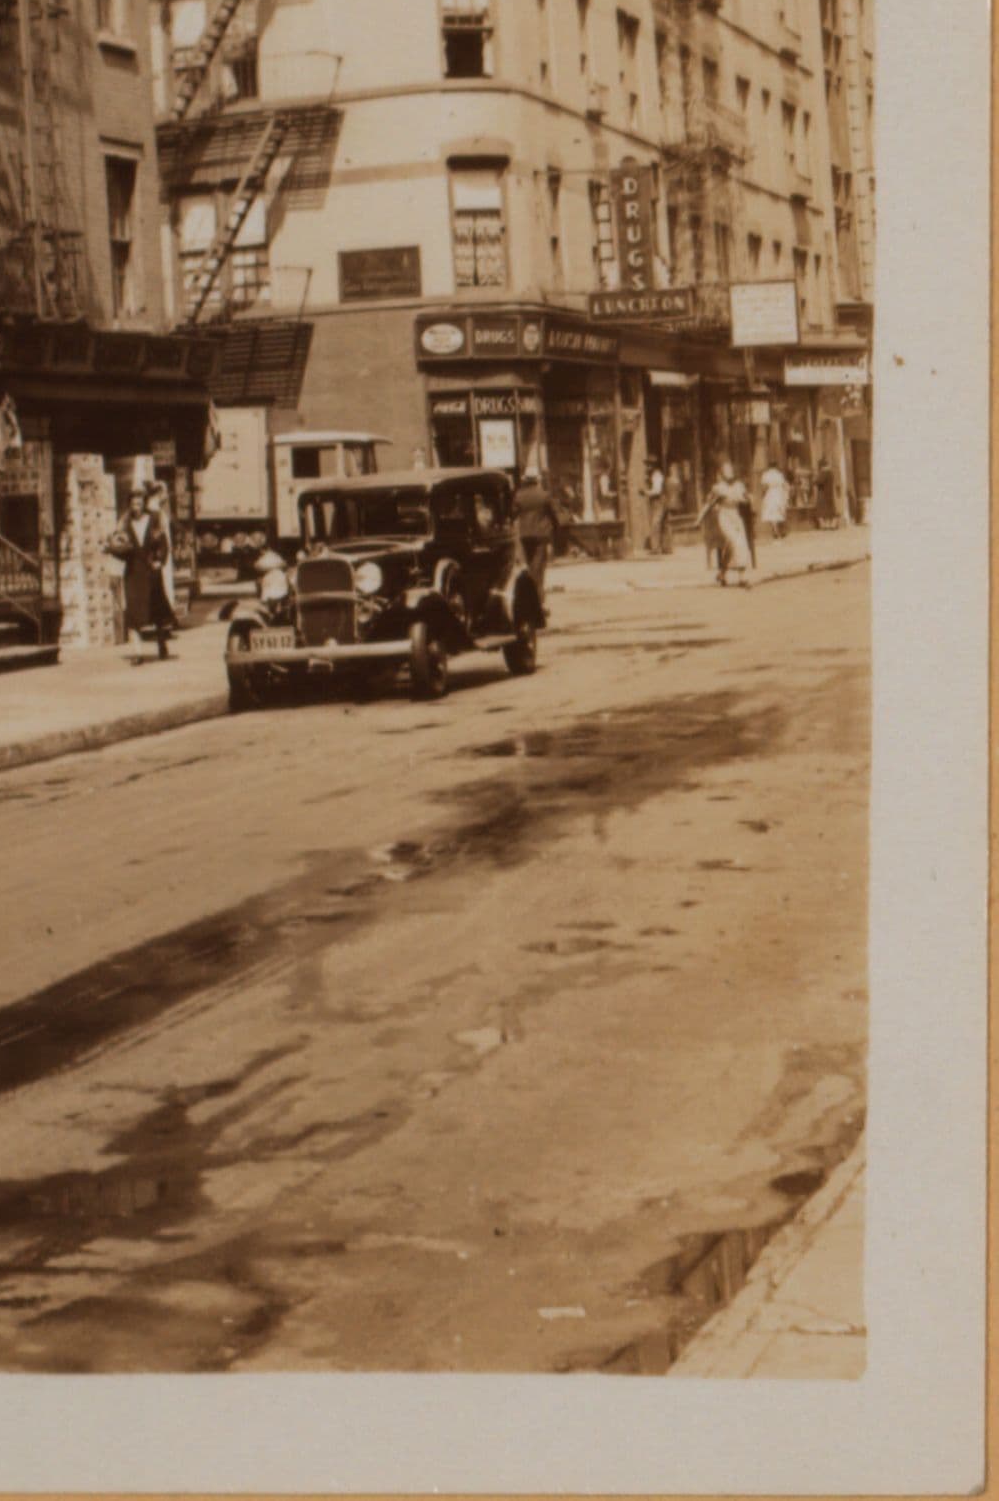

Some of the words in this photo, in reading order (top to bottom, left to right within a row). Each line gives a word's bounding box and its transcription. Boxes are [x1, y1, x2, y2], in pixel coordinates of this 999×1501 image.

[621, 177, 646, 292] DRUGS
[593, 295, 685, 316] LUNCHEON
[474, 328, 515, 345] DRUGS
[474, 395, 515, 415] DRUGS
